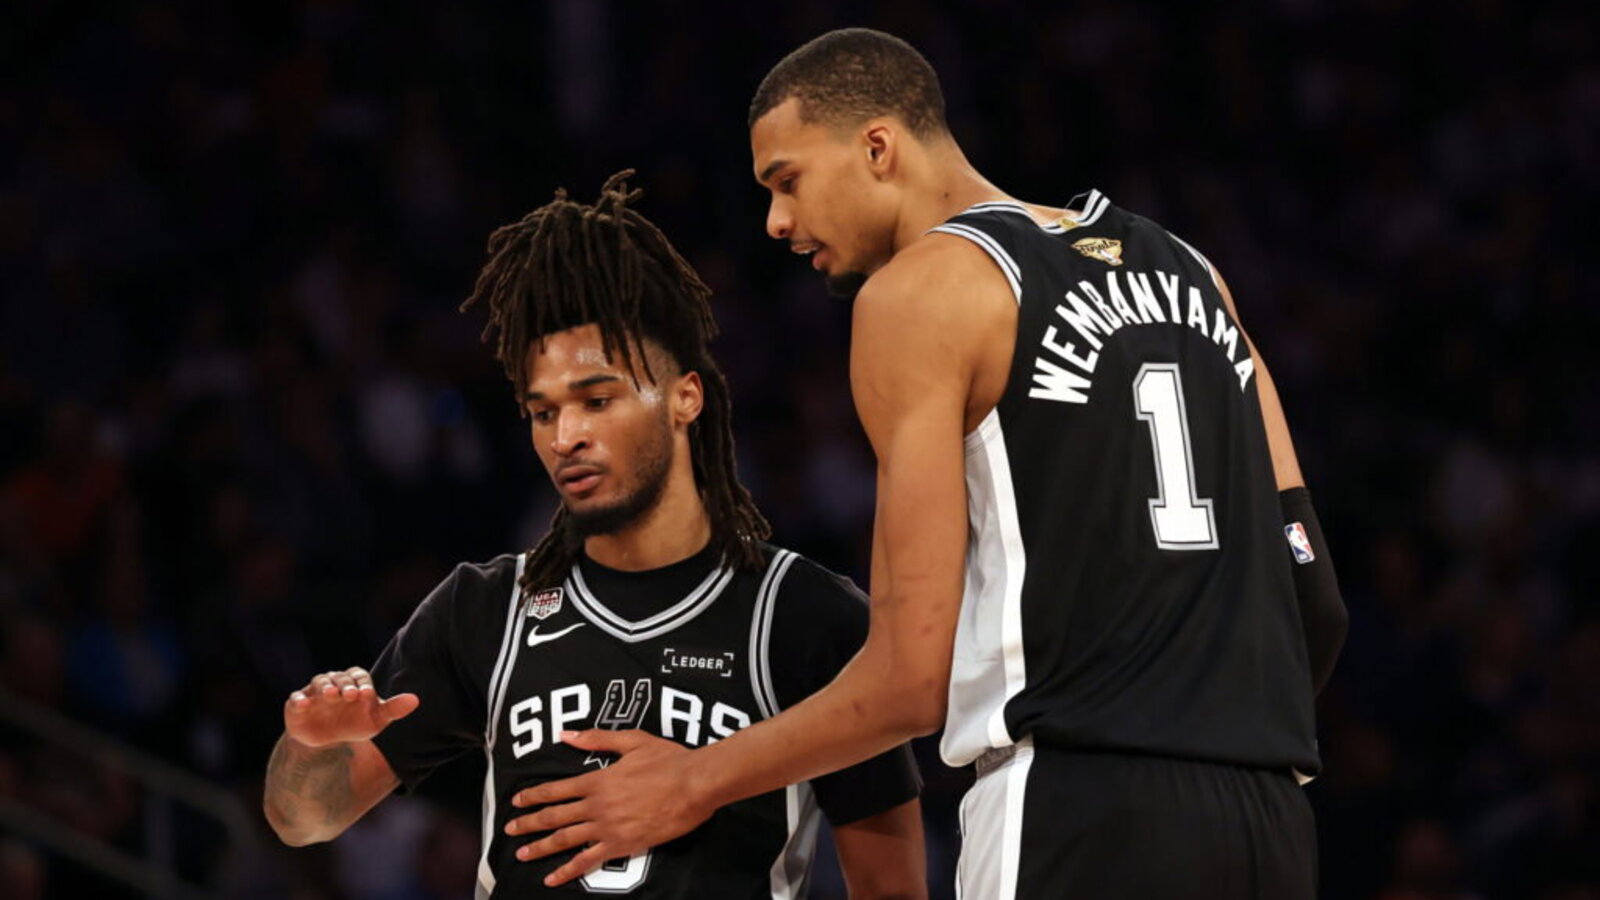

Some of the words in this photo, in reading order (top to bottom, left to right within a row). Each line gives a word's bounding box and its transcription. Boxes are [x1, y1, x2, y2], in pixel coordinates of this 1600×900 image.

[1028, 270, 1255, 404] WEMBANYAMA
[1132, 362, 1220, 550] 1
[671, 655, 724, 670] LEDGER
